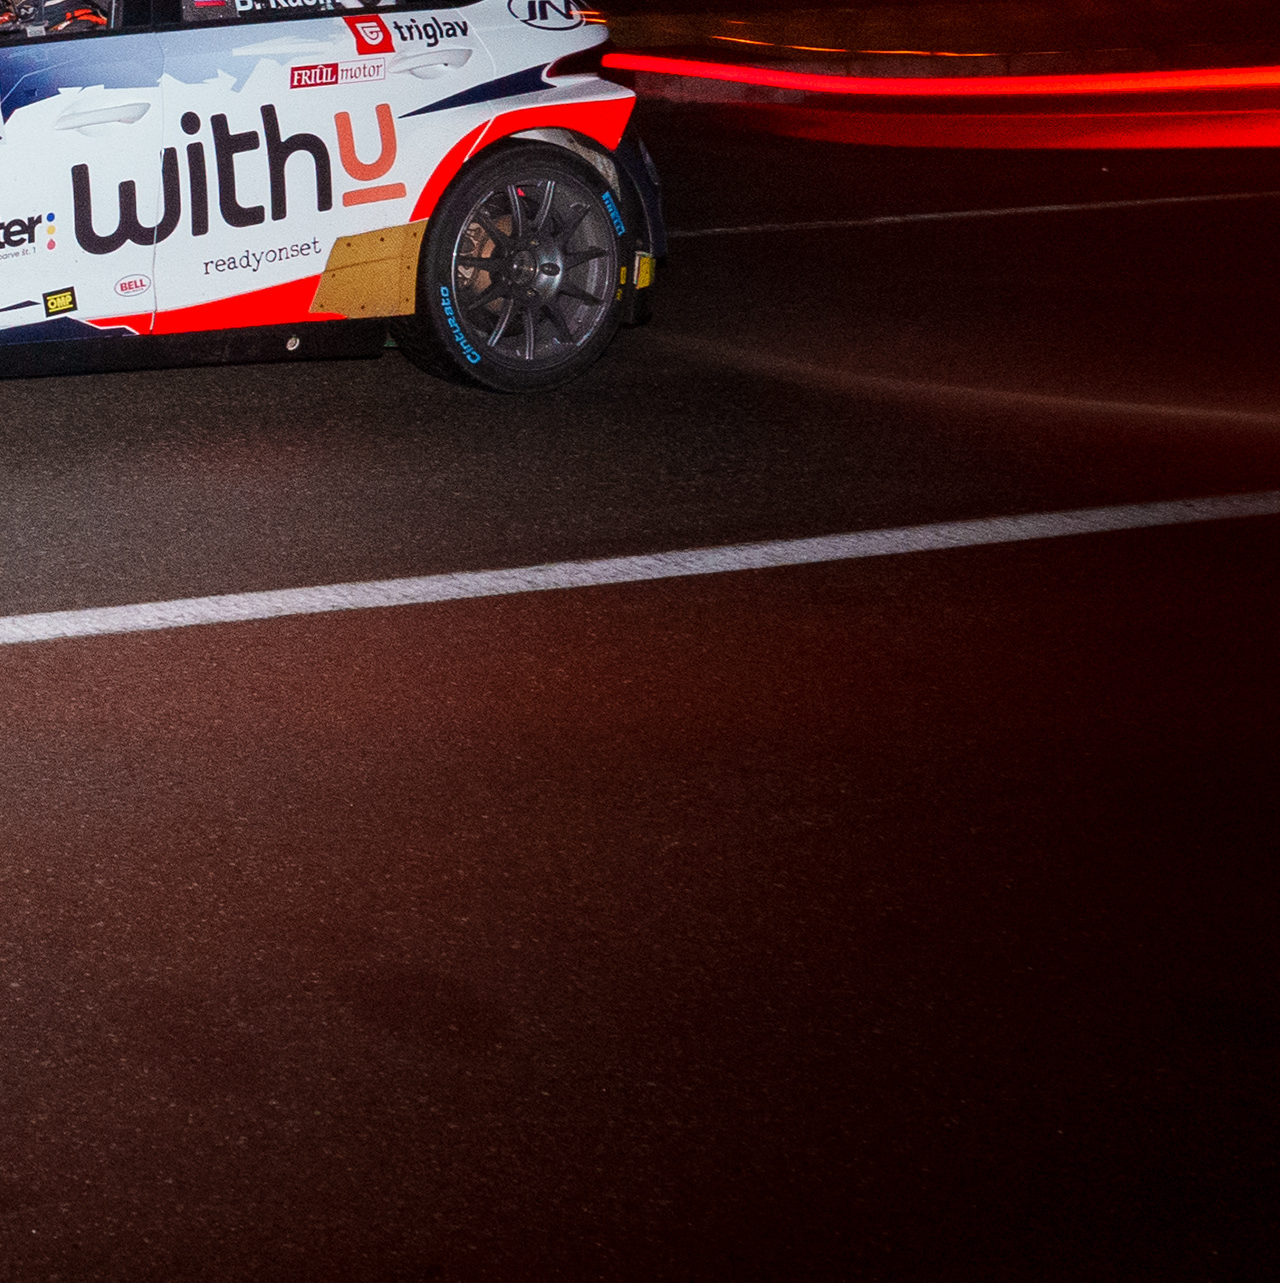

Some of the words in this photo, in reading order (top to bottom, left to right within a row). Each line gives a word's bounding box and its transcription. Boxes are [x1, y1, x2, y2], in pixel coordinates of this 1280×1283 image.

[394, 16, 469, 48] triglav
[340, 62, 383, 81] motor
[203, 236, 322, 276] readyonset
[119, 278, 147, 292] BELL
[47, 294, 72, 310] OMP
